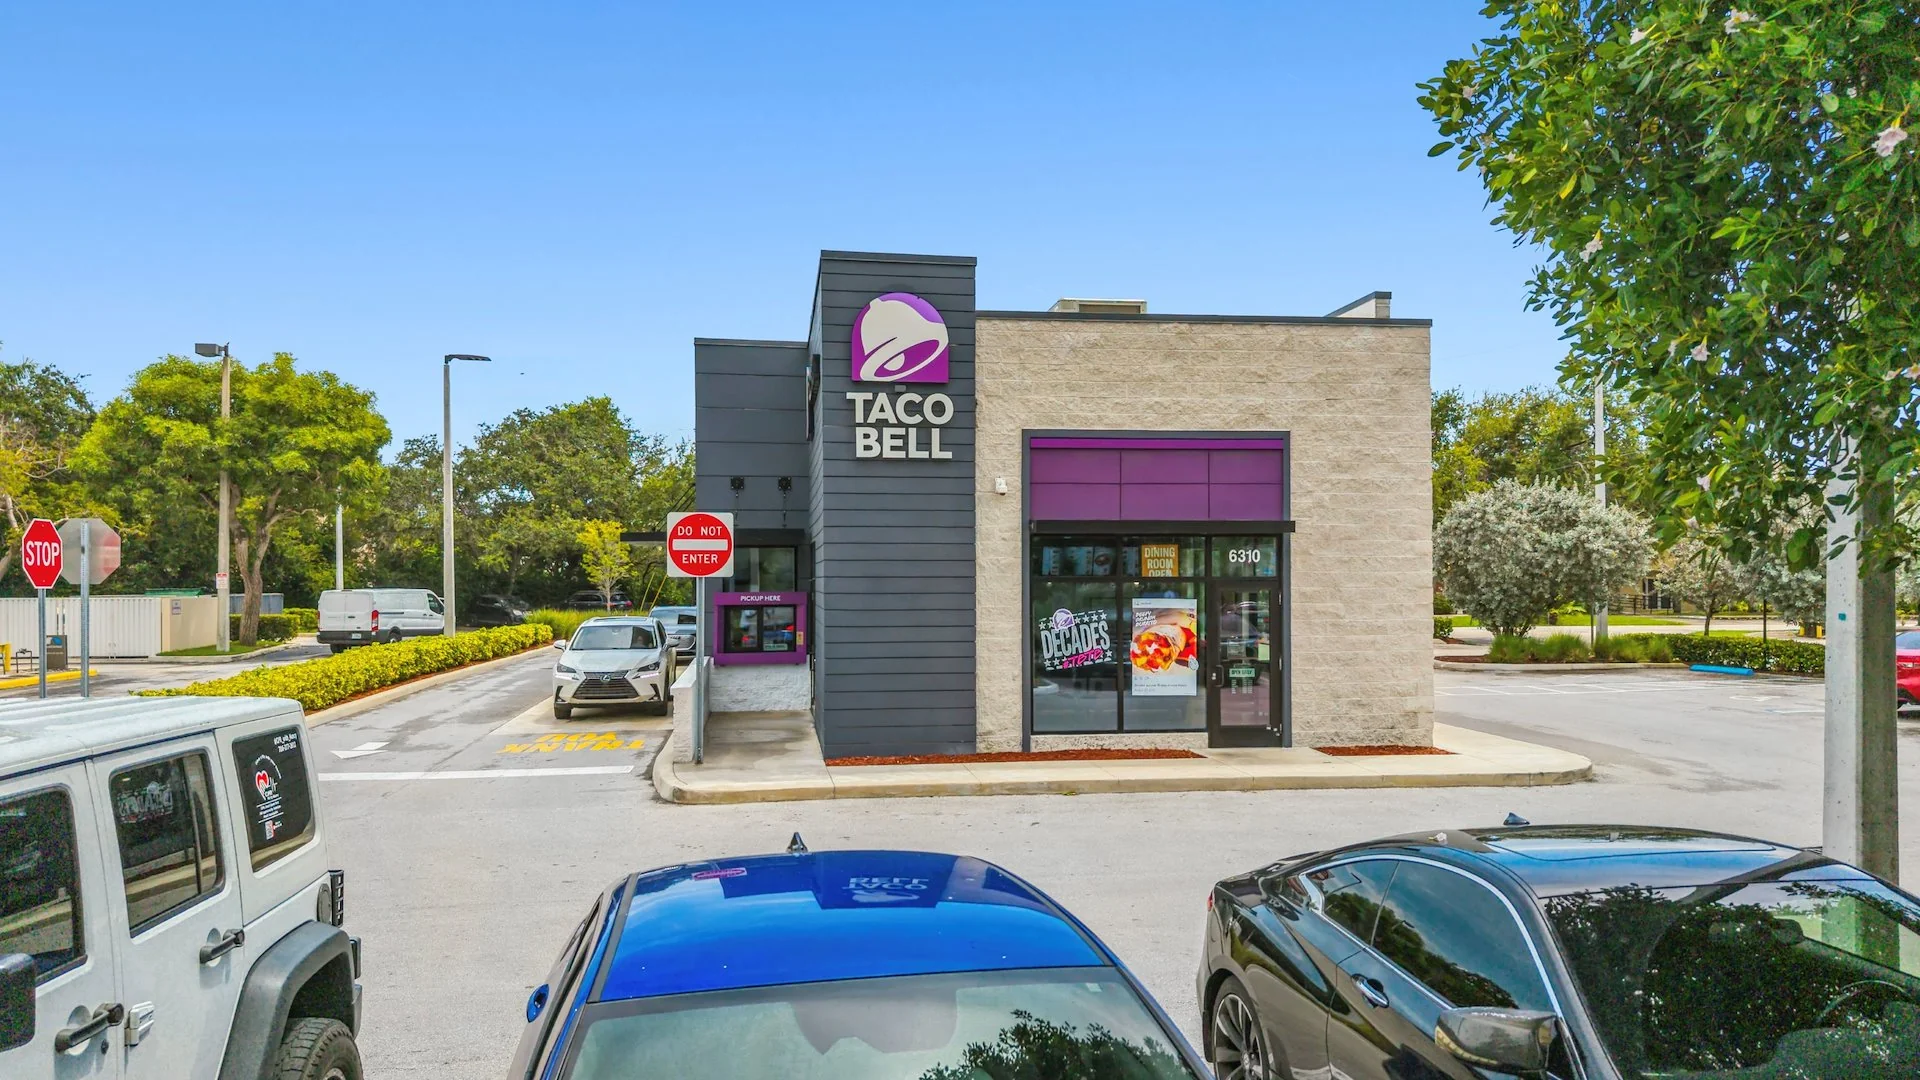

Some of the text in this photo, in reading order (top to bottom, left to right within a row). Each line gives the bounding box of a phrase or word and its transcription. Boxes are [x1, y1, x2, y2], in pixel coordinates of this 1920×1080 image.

[846, 392, 954, 425] TACO
[856, 427, 953, 459] BELL
[677, 526, 722, 536] DO NOT
[26, 540, 60, 567] STOP
[682, 553, 718, 564] ENTER
[1144, 547, 1176, 558] DINING
[1228, 549, 1261, 563] 6310
[1147, 558, 1174, 569] ROOM
[1041, 620, 1111, 659] DECADES
